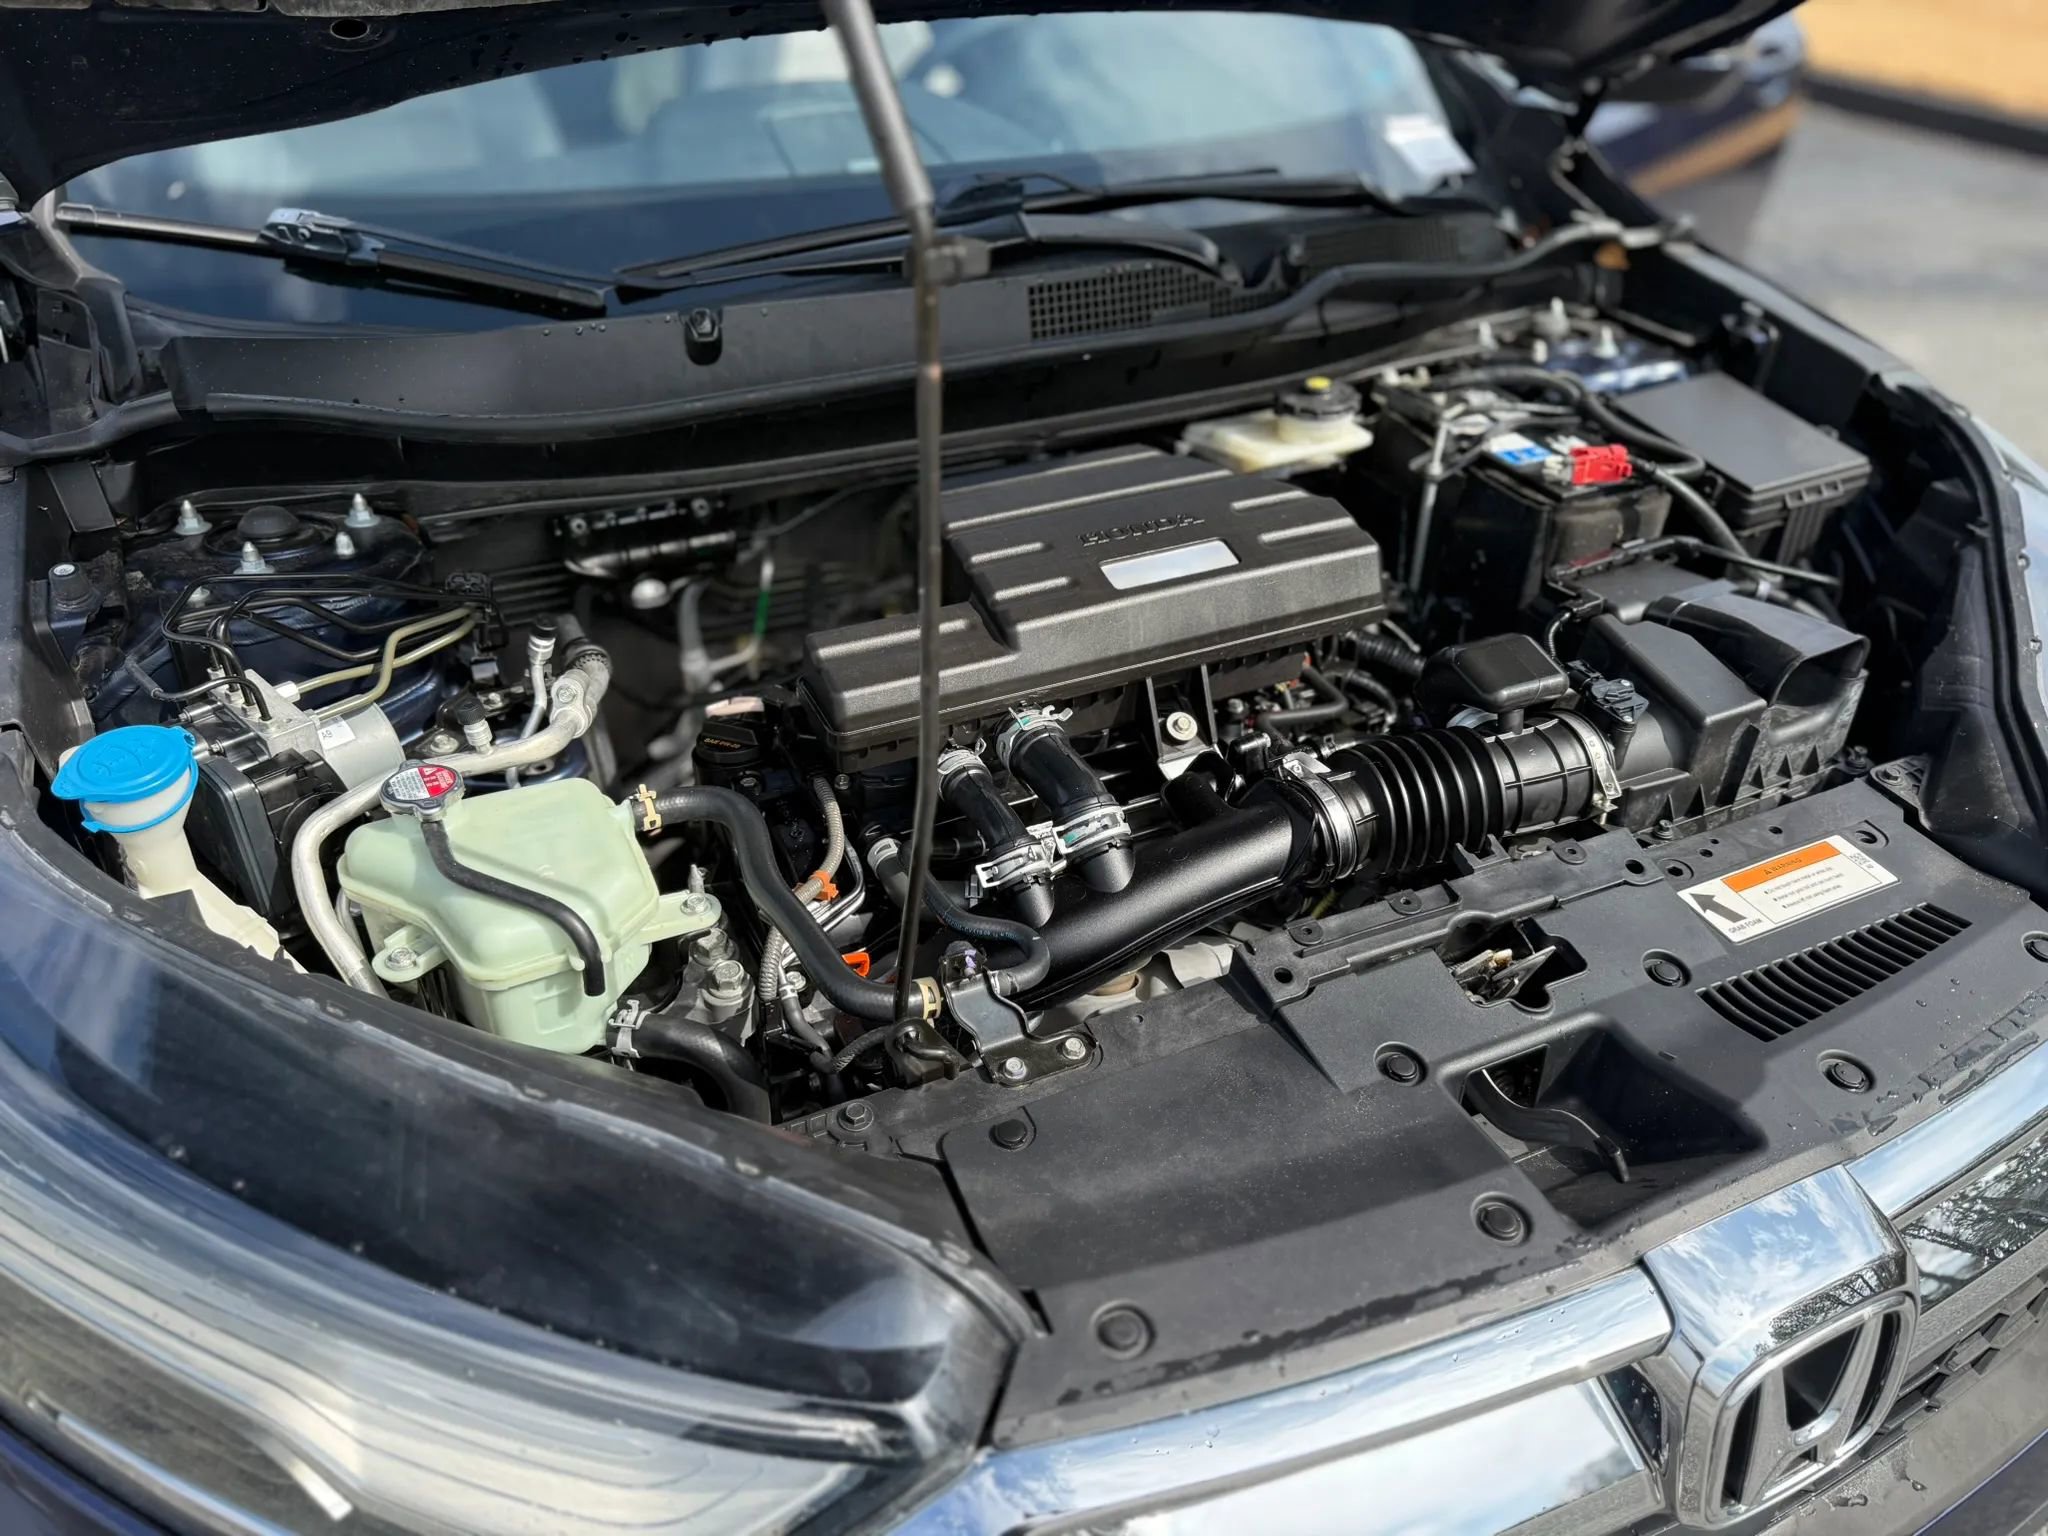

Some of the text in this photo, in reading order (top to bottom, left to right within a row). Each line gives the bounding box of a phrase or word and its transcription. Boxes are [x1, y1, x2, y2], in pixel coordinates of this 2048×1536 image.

[1076, 513, 1205, 547] HONDA
[1728, 918, 1762, 933] GRAB FOAM
